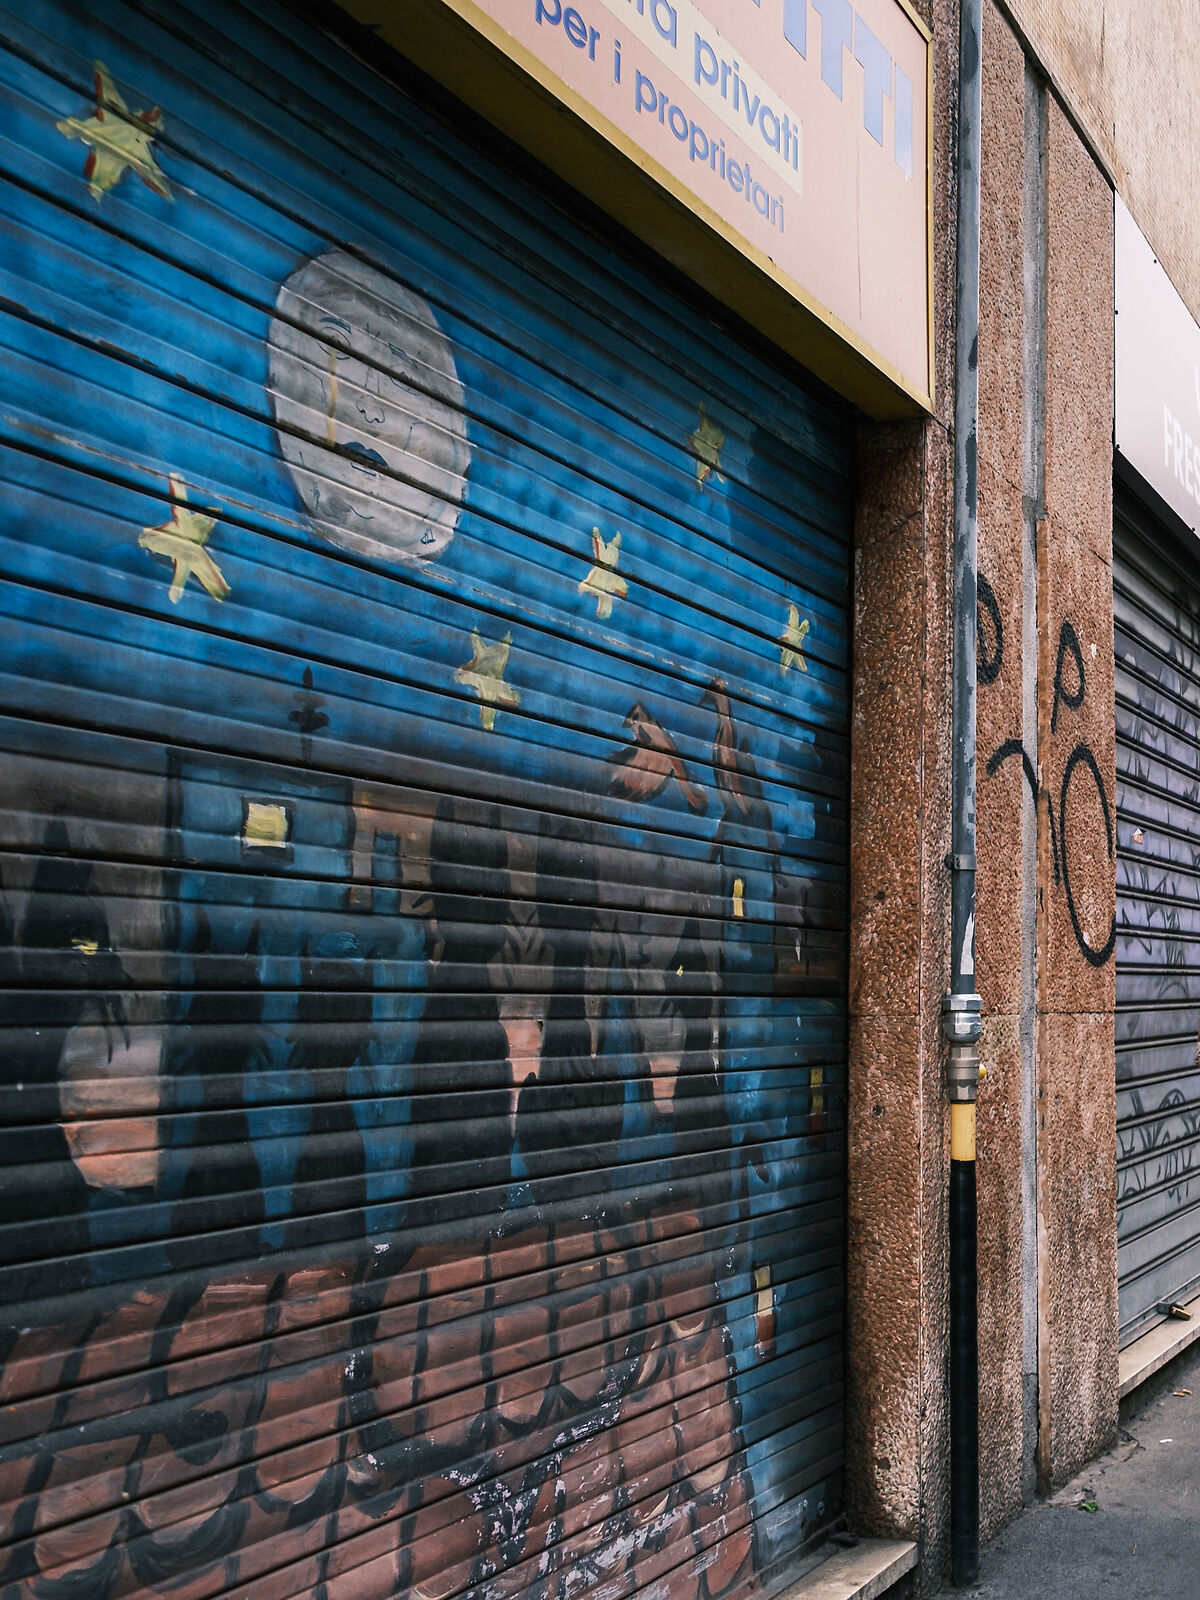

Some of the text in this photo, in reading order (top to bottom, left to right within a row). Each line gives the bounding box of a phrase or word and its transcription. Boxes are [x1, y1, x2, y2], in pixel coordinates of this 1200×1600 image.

[535, 0, 785, 234] per i proprietari
[694, 32, 800, 171] privati
